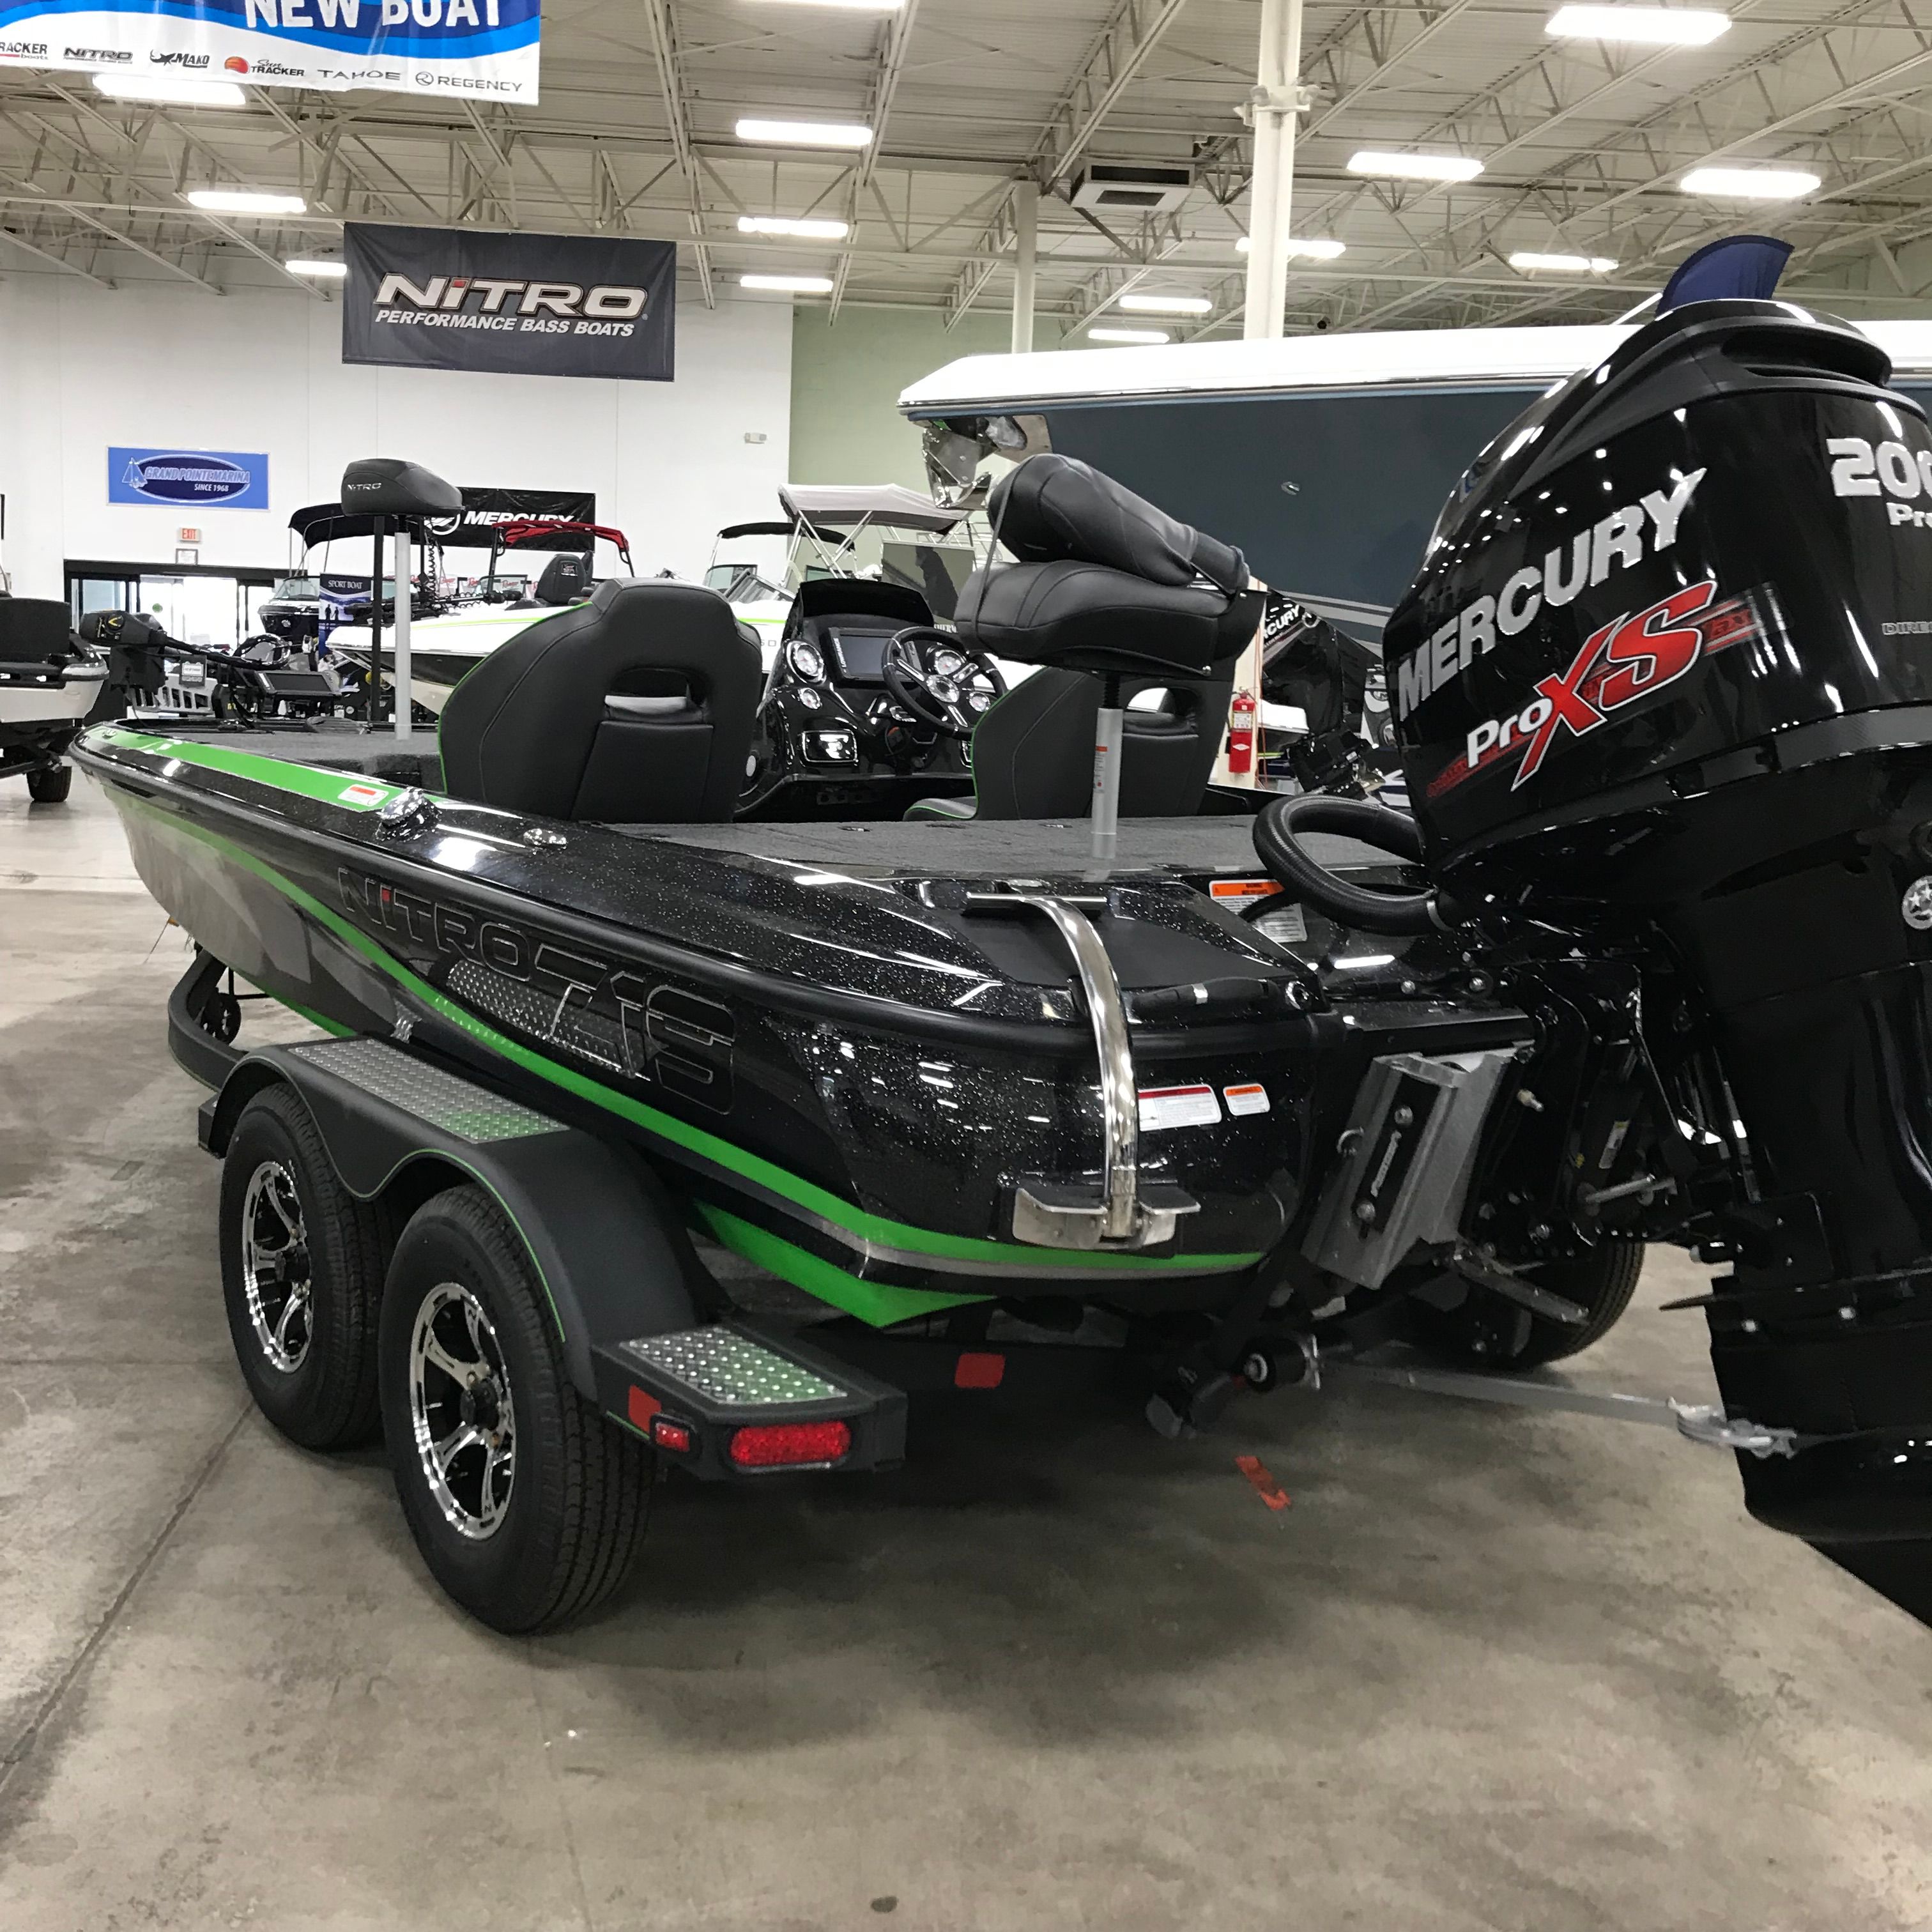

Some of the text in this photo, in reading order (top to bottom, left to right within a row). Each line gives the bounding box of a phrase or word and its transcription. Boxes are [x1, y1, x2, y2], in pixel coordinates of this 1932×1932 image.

[245, 0, 360, 27] NEW
[0, 42, 48, 55] RACKER
[251, 65, 305, 77] TRACKER
[317, 69, 401, 80] TAHOE
[438, 77, 523, 93] REGENCY
[375, 310, 635, 337] PERFORMANCE BASS BOATS
[213, 484, 229, 492] 1968
[182, 528, 195, 539] EXIT
[328, 579, 363, 589] SPORT BOAT
[1397, 467, 1707, 722] MERCURY
[1264, 604, 1300, 639] CURY
[1882, 622, 1932, 635] DIRE
